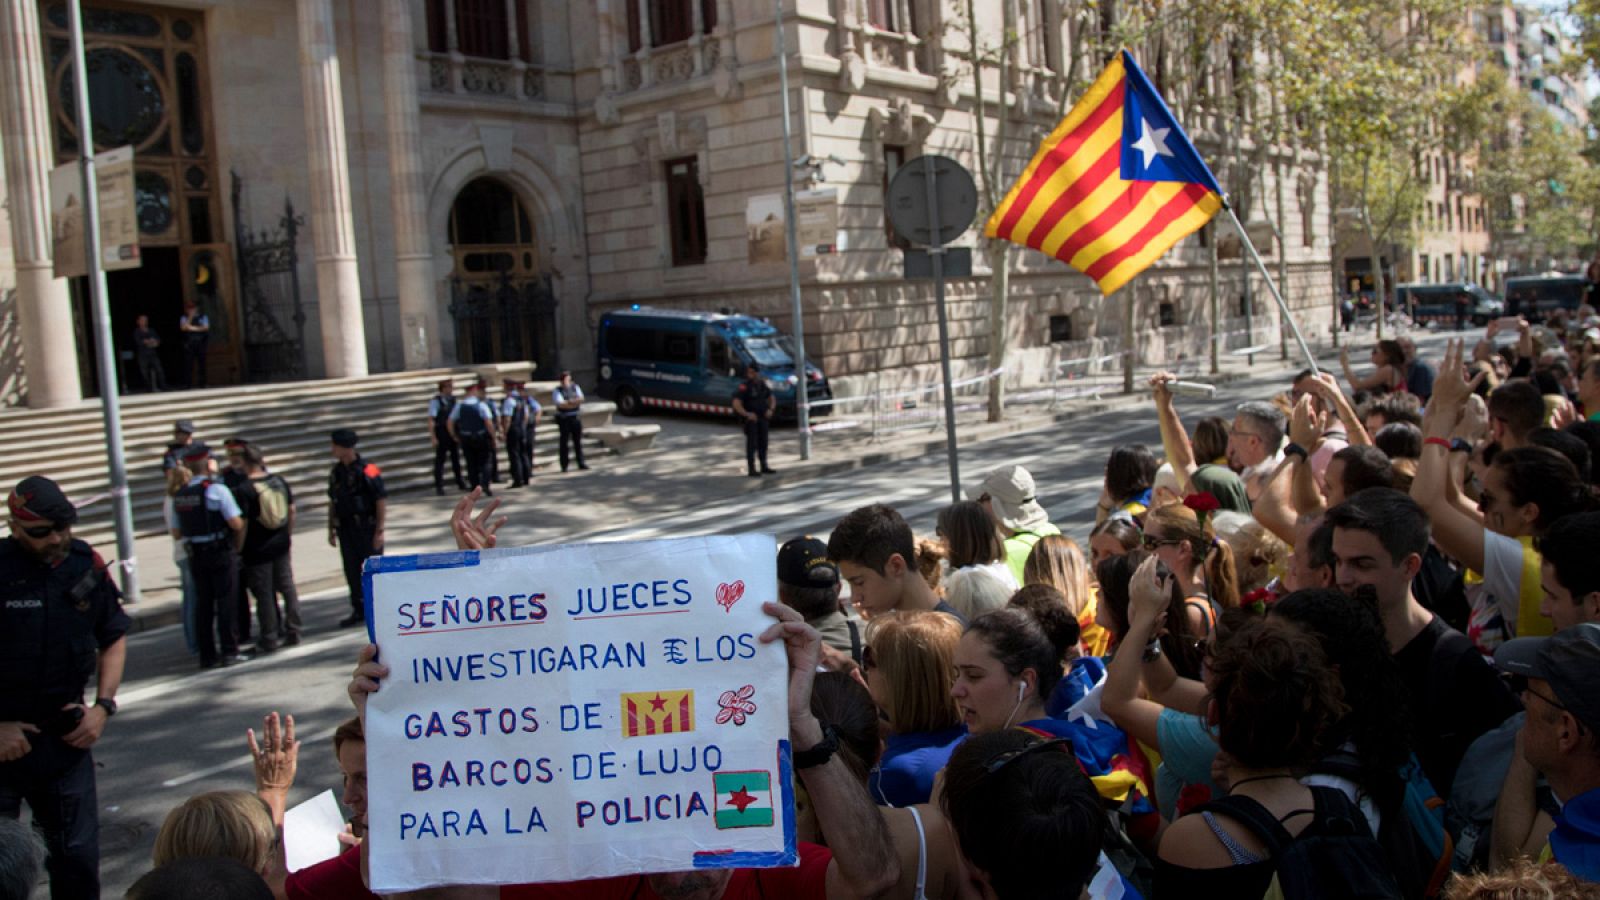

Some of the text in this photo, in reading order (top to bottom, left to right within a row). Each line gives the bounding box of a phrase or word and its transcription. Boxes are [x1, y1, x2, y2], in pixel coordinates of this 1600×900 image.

[5, 600, 43, 608] POLICIA
[397, 579, 693, 630] SEÑORES JUECES
[412, 642, 646, 684] INVESTIGARAN
[696, 633, 757, 662] LOS
[405, 703, 602, 740] GASTOS DE
[412, 745, 722, 791] BARCOS DE LUJO
[399, 792, 709, 841] PARA LA POLICIA
